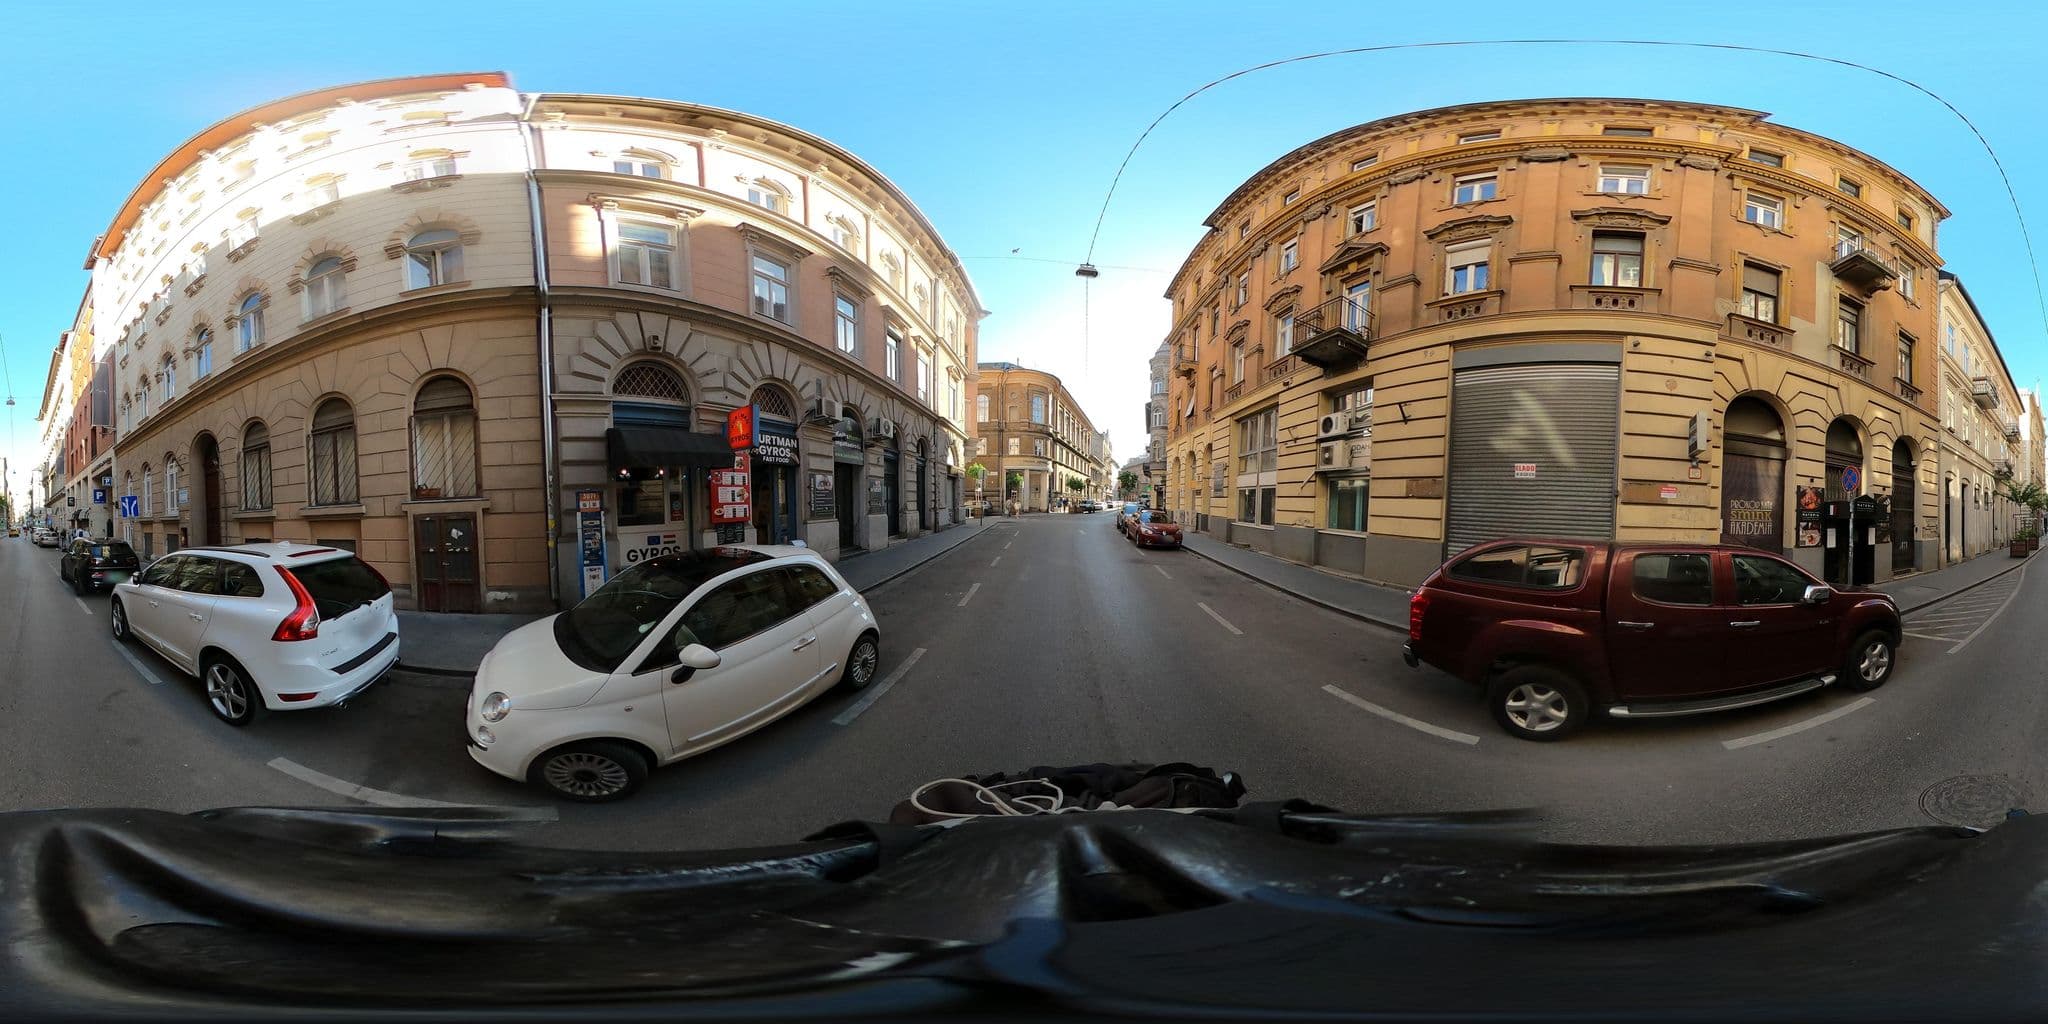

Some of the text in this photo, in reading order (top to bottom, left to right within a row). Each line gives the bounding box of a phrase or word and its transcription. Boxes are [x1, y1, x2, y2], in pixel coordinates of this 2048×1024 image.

[758, 434, 797, 449] URTMAN
[759, 445, 791, 458] GYROS
[96, 491, 103, 499] P
